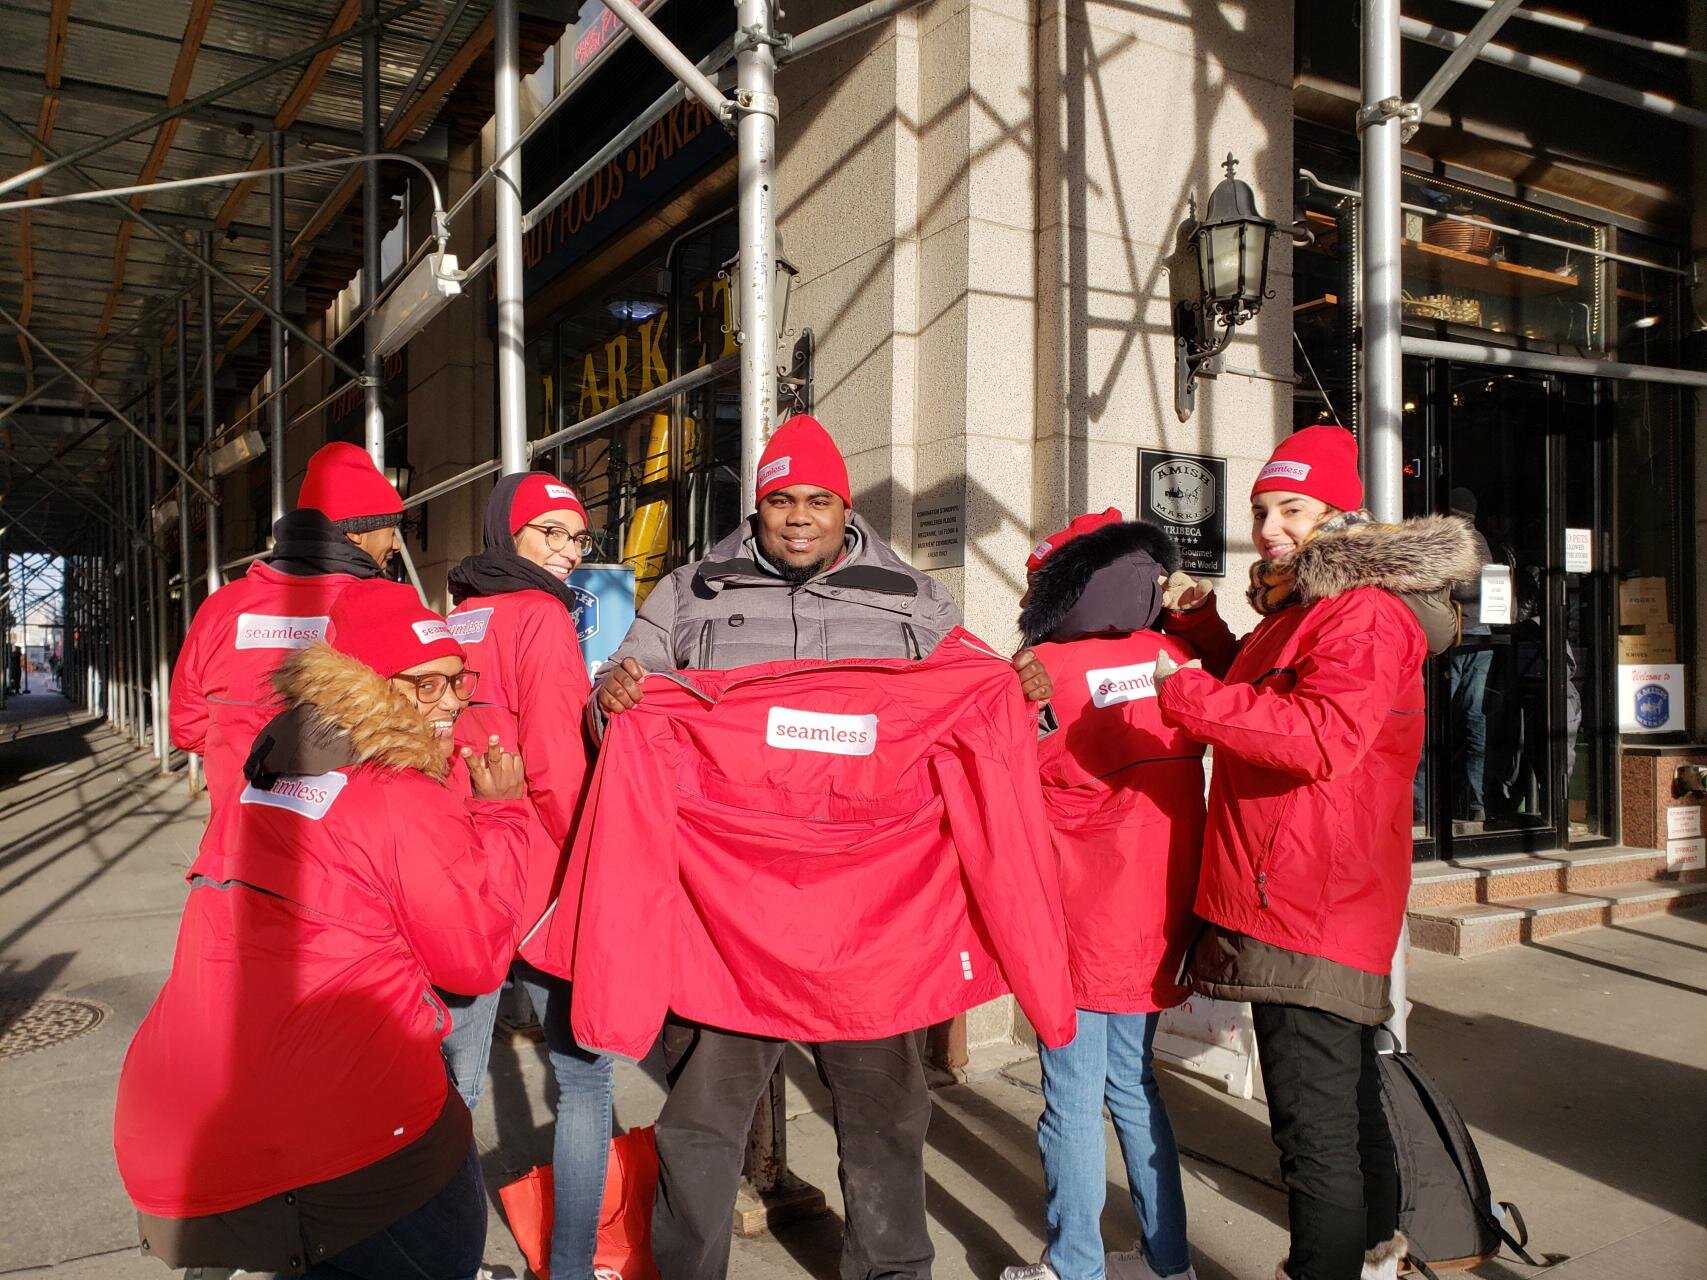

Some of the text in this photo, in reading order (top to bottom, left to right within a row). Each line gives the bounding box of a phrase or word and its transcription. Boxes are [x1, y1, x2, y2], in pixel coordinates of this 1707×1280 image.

[639, 100, 712, 181] BAKER
[1157, 465, 1211, 486] AMISH
[1156, 503, 1211, 520] MARKET
[1164, 525, 1202, 537] TRIBECA
[1181, 547, 1213, 558] Gourmet
[1184, 560, 1197, 569] the
[1197, 560, 1218, 570] World
[244, 626, 319, 640] seamless
[776, 724, 868, 744] seamless
